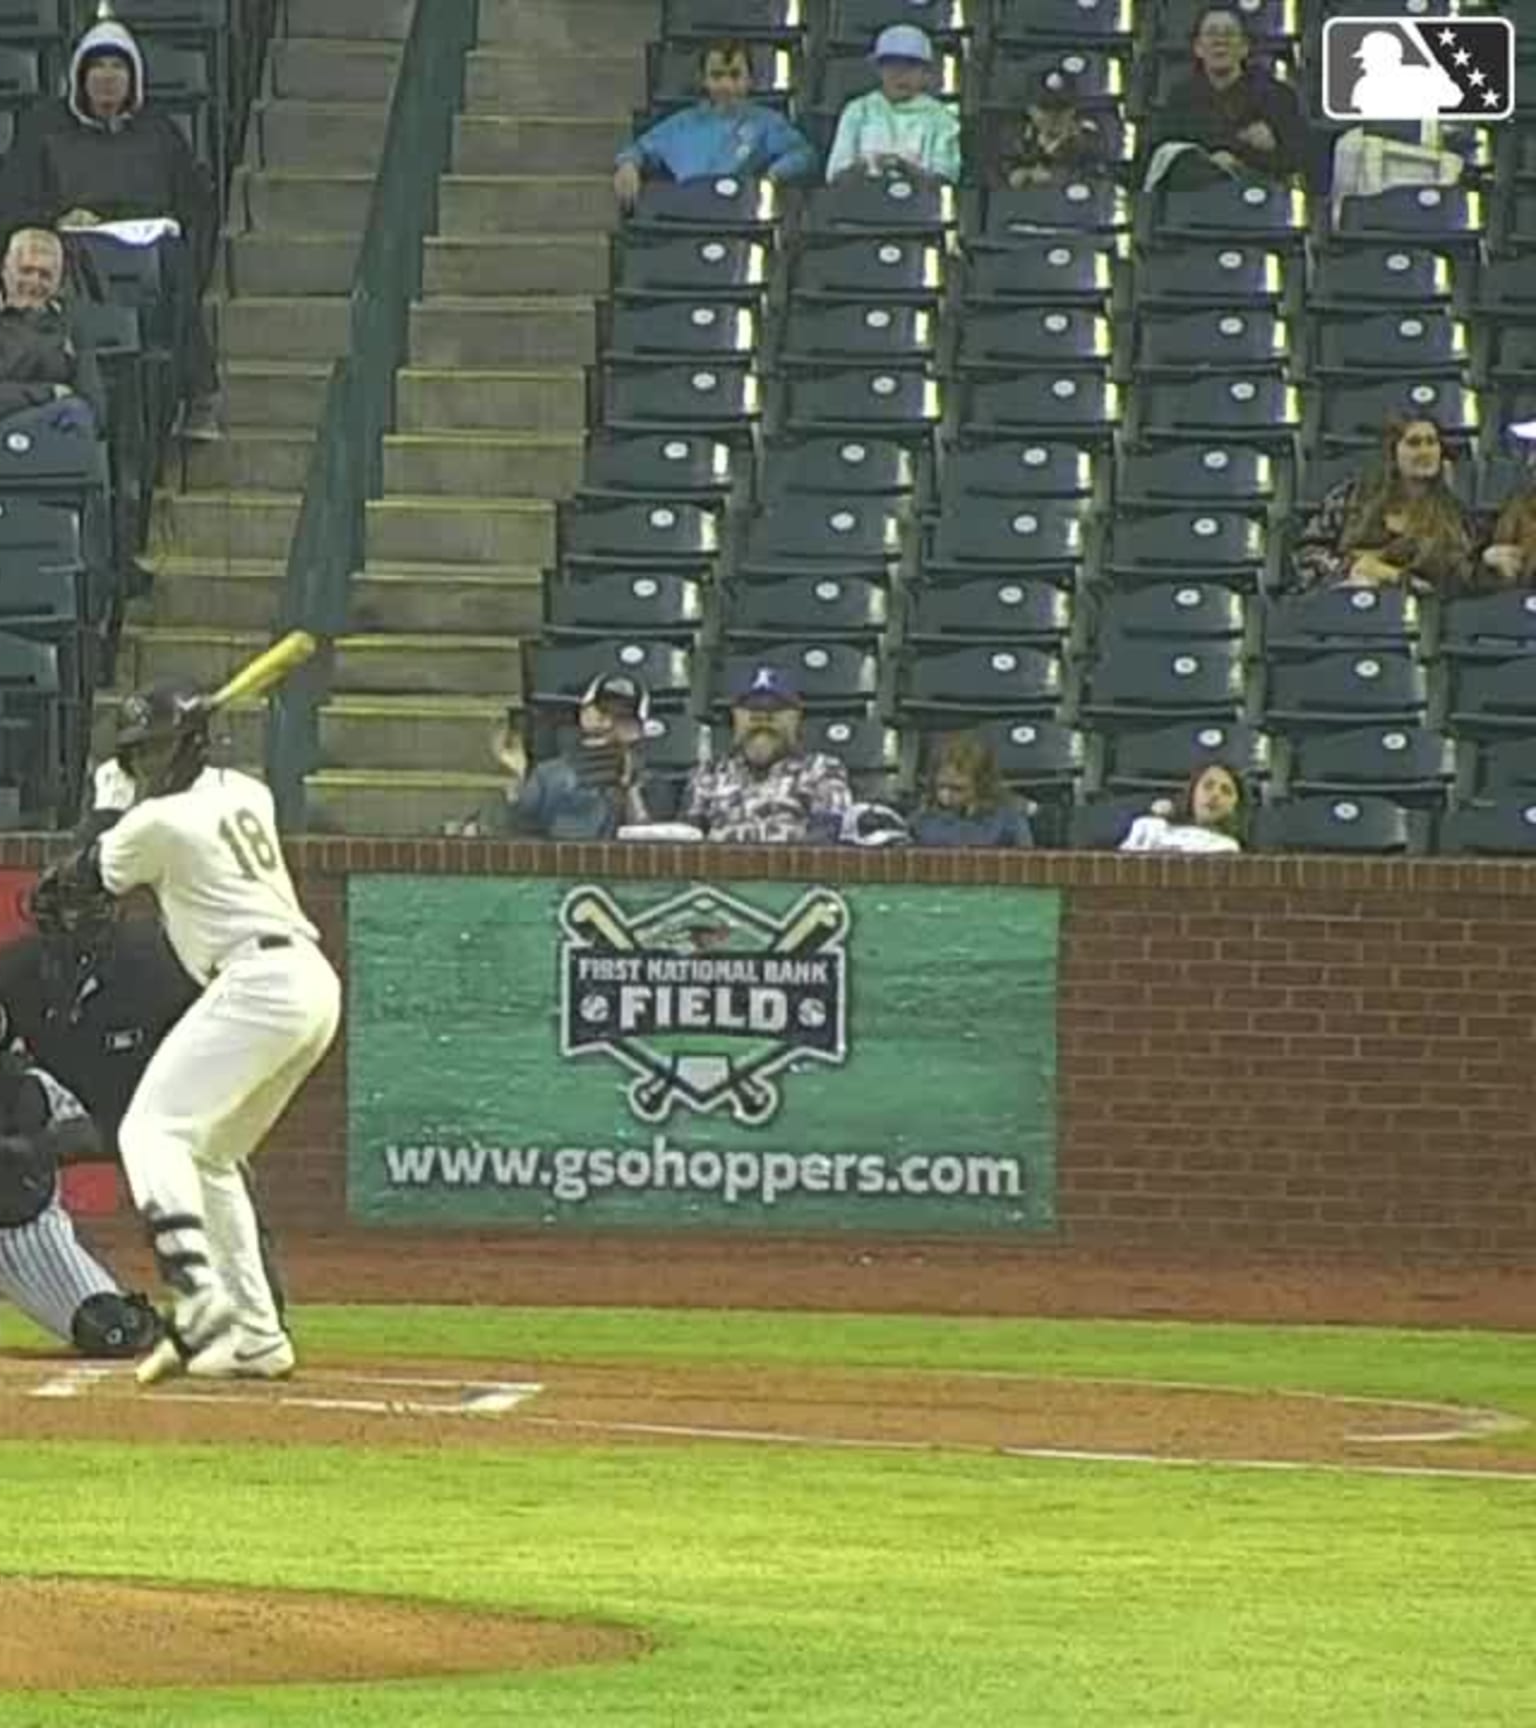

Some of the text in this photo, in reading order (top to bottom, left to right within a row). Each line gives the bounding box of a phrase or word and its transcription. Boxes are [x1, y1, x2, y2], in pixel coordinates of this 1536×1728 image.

[218, 807, 278, 882] 18
[578, 957, 829, 985] FIRST NATIONAL BANK
[618, 985, 789, 1032] FIELD
[386, 1136, 1022, 1202] www.gsohoppers.com
